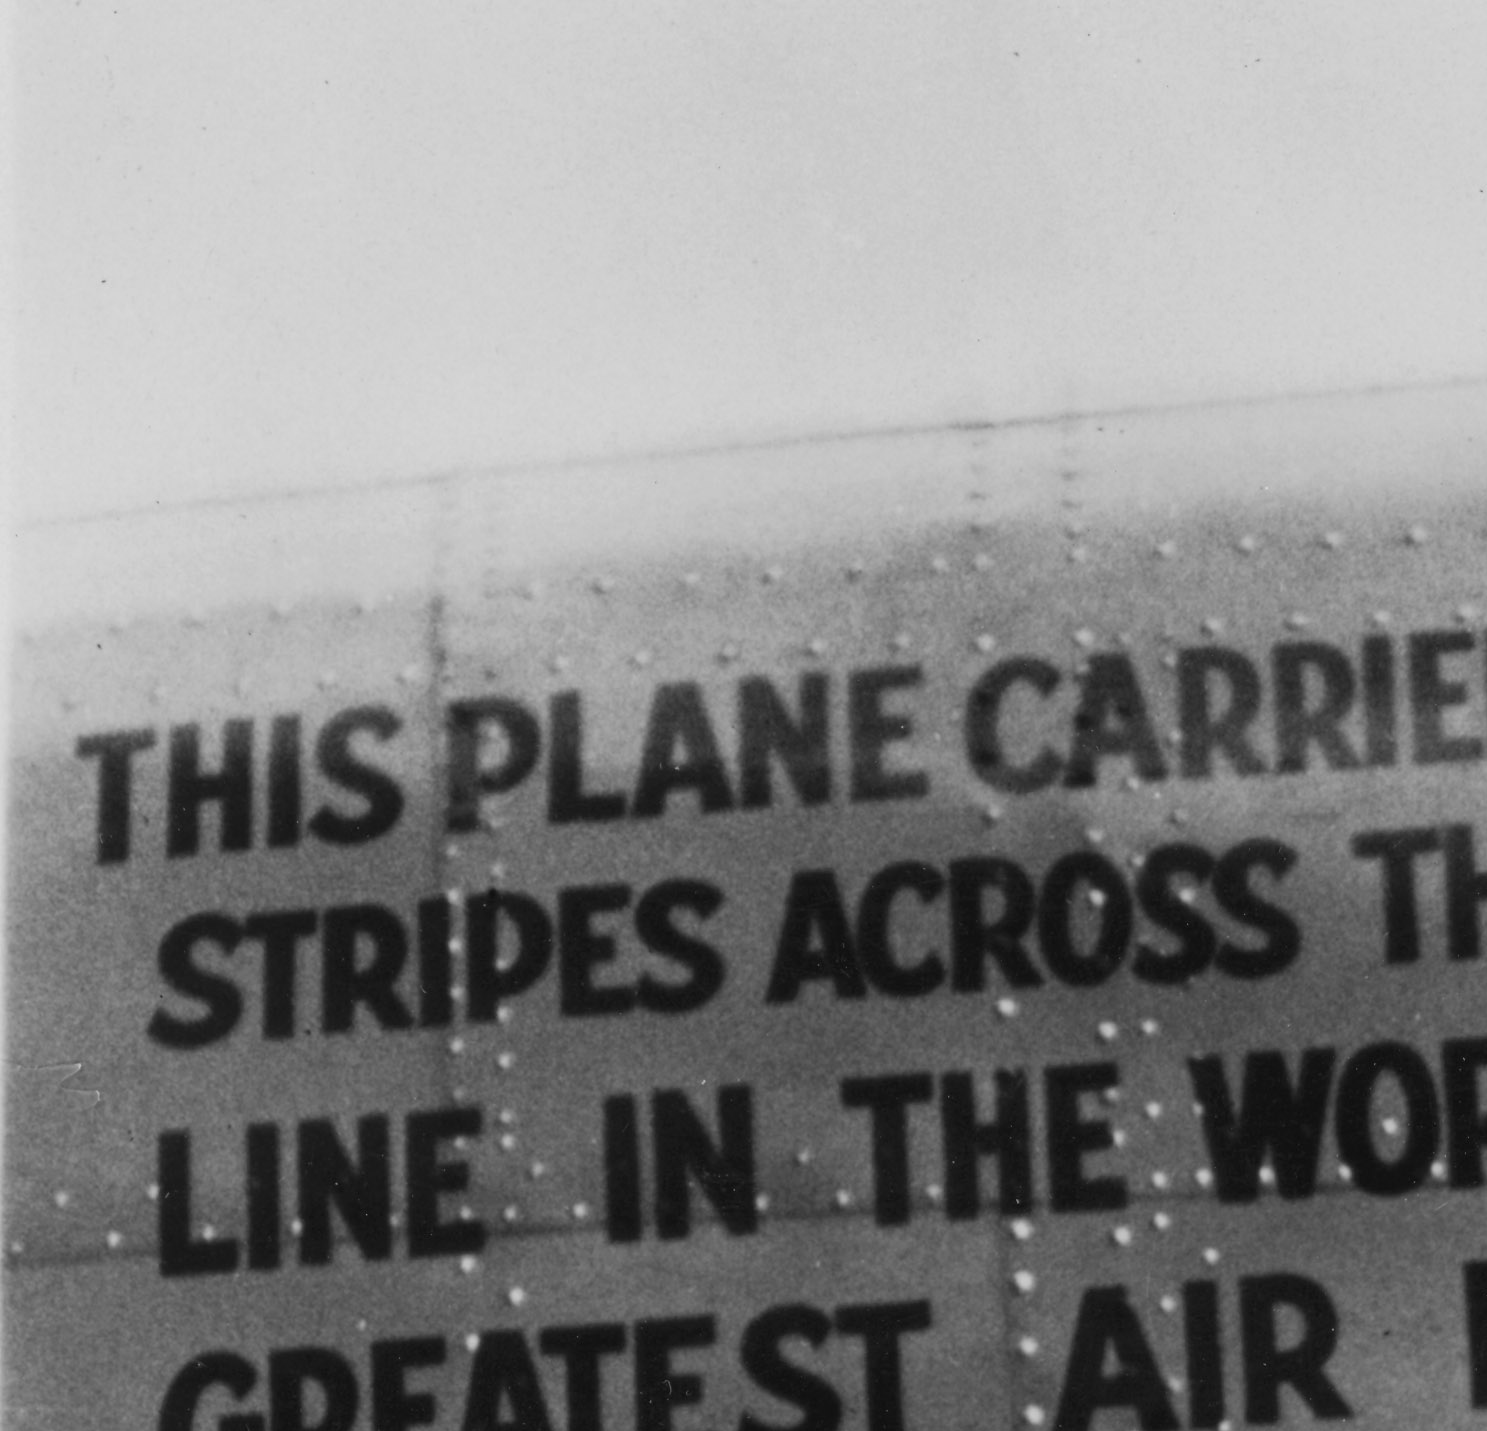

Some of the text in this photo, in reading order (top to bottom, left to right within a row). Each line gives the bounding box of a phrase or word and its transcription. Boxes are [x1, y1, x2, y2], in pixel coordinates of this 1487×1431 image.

[75, 703, 405, 867] THIS
[443, 663, 932, 833] PLANE
[146, 876, 728, 1050] STRIPES
[764, 838, 1302, 1006] ACROSS
[156, 1105, 486, 1278] LINE
[602, 1083, 762, 1244] IN
[840, 1060, 1130, 1228] THE
